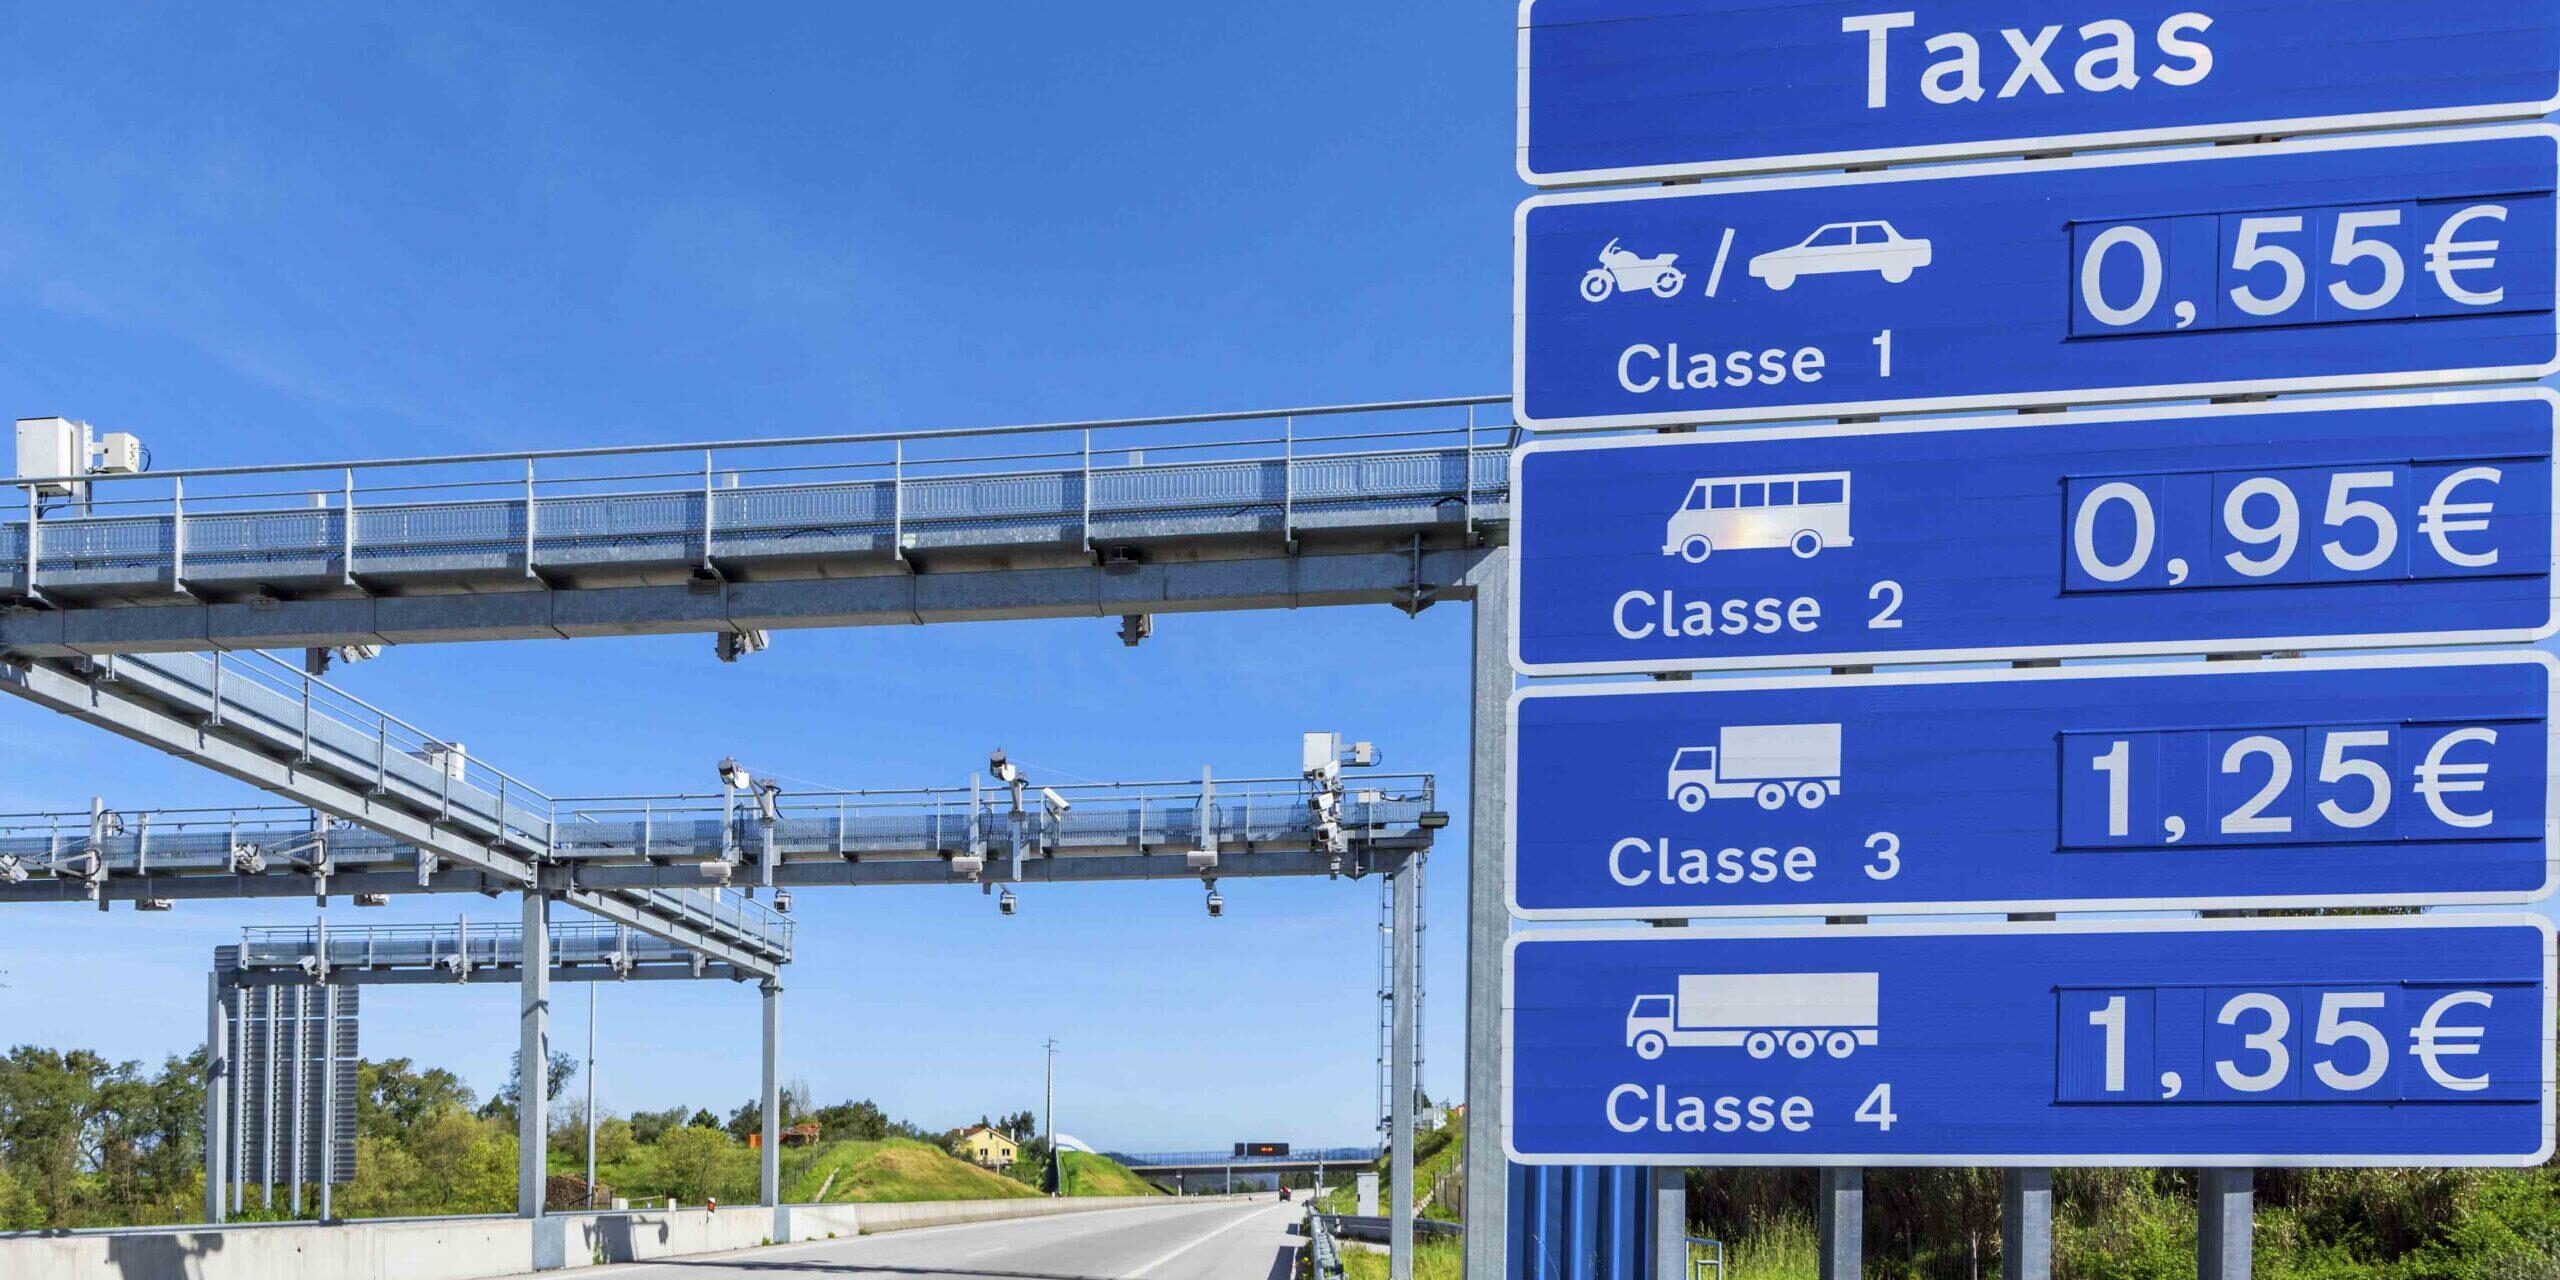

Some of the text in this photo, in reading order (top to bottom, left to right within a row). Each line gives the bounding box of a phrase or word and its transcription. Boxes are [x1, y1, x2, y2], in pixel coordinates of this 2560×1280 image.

[1843, 12, 2213, 108] Taxas
[2082, 204, 2508, 328] 0,55€
[1619, 330, 1891, 392] Classe 1
[2075, 466, 2502, 586] 0,95€
[1614, 581, 1903, 639] Classe 2
[2093, 727, 2498, 842] 1,25€
[1610, 832, 1900, 885] Classe 3
[2089, 990, 2494, 1098] 1,35€
[1606, 1083, 1898, 1132] Classe 4
